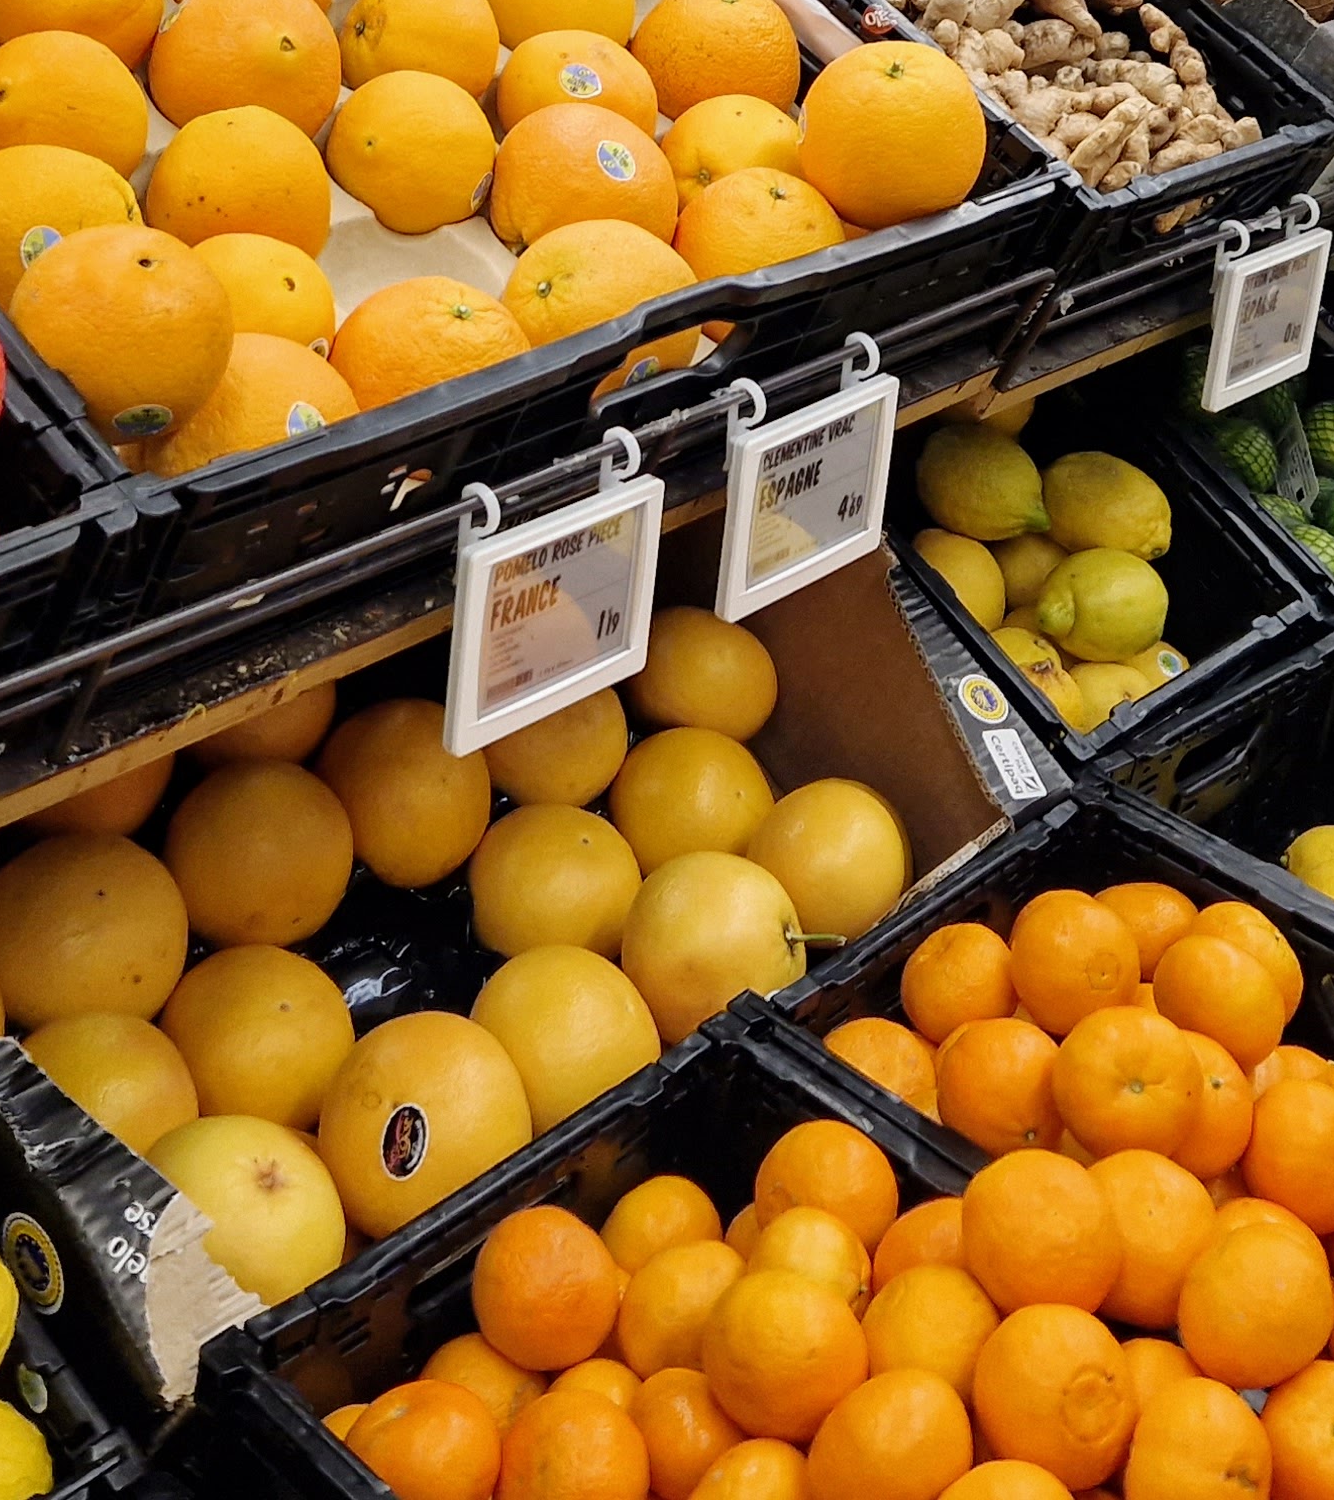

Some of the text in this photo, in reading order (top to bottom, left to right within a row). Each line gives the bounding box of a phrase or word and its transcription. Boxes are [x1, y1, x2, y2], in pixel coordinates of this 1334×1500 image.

[763, 414, 855, 472] CLEMENTINE VRAC
[759, 458, 823, 513] ESPAGNE
[493, 551, 547, 587] POMELO
[551, 532, 584, 563] ROSE
[490, 575, 561, 631] FRANCE
